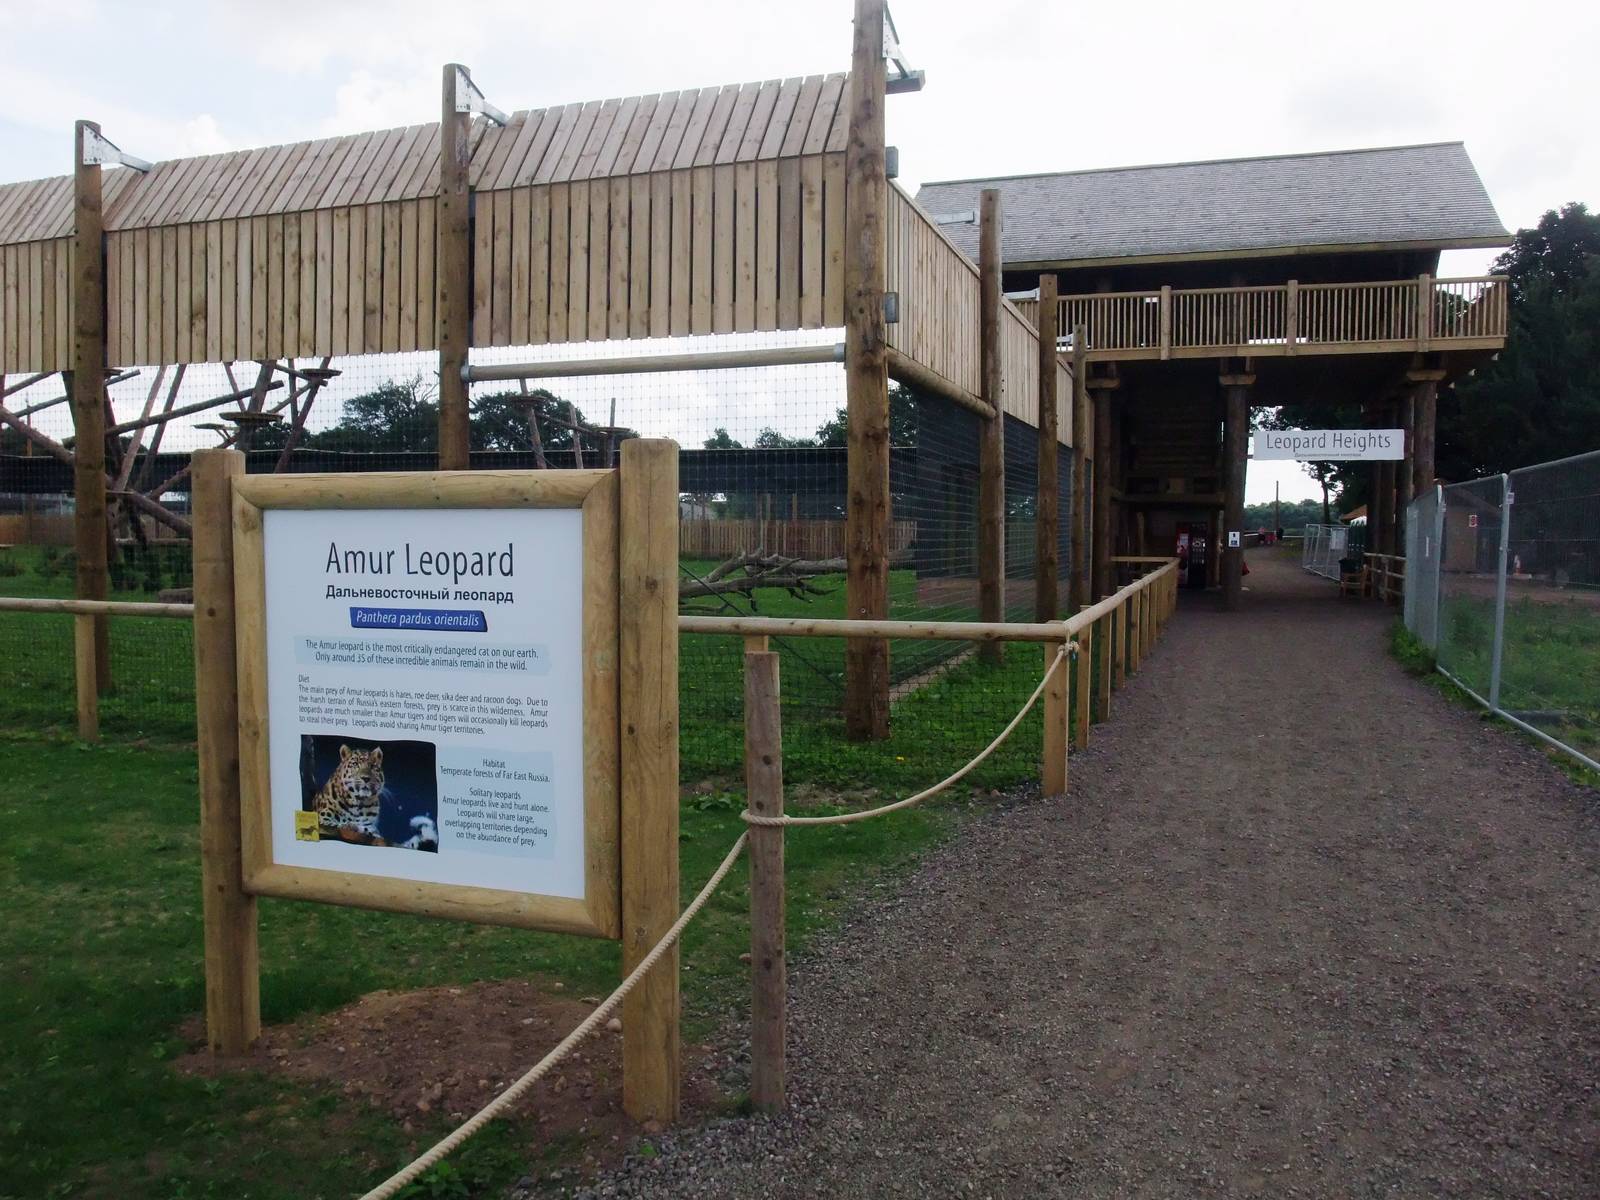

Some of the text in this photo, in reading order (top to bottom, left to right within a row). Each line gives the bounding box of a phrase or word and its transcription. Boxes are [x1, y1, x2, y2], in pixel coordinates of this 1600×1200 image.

[1267, 432, 1391, 452] Leopard Heights
[326, 542, 514, 584] Amur Leopard
[326, 585, 514, 604] Дальневосточный леопард
[357, 611, 479, 627] Panthera pardus orientalis
[306, 640, 317, 648] The
[320, 640, 337, 649] Amur
[339, 641, 363, 652] leopard
[366, 643, 370, 651] is
[373, 643, 384, 651] the
[386, 645, 402, 653] most
[404, 644, 433, 655] critically
[435, 646, 476, 656] endangered
[479, 648, 489, 656] cat
[503, 650, 514, 658] our
[316, 652, 527, 670] Only around 35 of these incredible animals remain in the wild.
[299, 684, 308, 693] The
[326, 688, 338, 696] prey
[340, 687, 345, 695] of
[347, 688, 362, 696] Amur
[364, 688, 388, 698] leopards
[442, 693, 453, 701] sika
[455, 693, 468, 702] deer
[527, 697, 539, 706] Due
[335, 707, 350, 715] much
[390, 710, 405, 719] Amur
[408, 711, 427, 721] tigers
[439, 714, 456, 723] tigers
[458, 714, 469, 723] will
[471, 715, 507, 727] occasionally
[509, 717, 519, 725] kill
[521, 718, 548, 729] leopards
[427, 703, 440, 712] prey
[470, 705, 476, 713] in
[477, 705, 488, 713] this
[530, 709, 548, 717] Amur
[352, 718, 378, 728] Leopards
[380, 720, 395, 728] avoid
[397, 720, 418, 731] sharing
[420, 723, 437, 732] Amur
[439, 725, 453, 733] tiger
[483, 759, 505, 768] Habitat
[441, 766, 472, 776] Temperate
[474, 768, 494, 778] forests
[495, 770, 501, 778] of
[503, 771, 512, 780] Far
[514, 772, 526, 780] East
[469, 787, 521, 800] Solitary leopards
[443, 796, 459, 804] Amur
[461, 797, 486, 807] leopards
[488, 800, 499, 808] live
[514, 802, 528, 810] hunt
[457, 808, 485, 818] Leopards
[486, 811, 497, 819] will
[499, 812, 516, 821] share
[445, 820, 547, 837] overlapping territories depending
[466, 831, 476, 839] the
[478, 833, 511, 843] abundance
[513, 836, 519, 844] of
